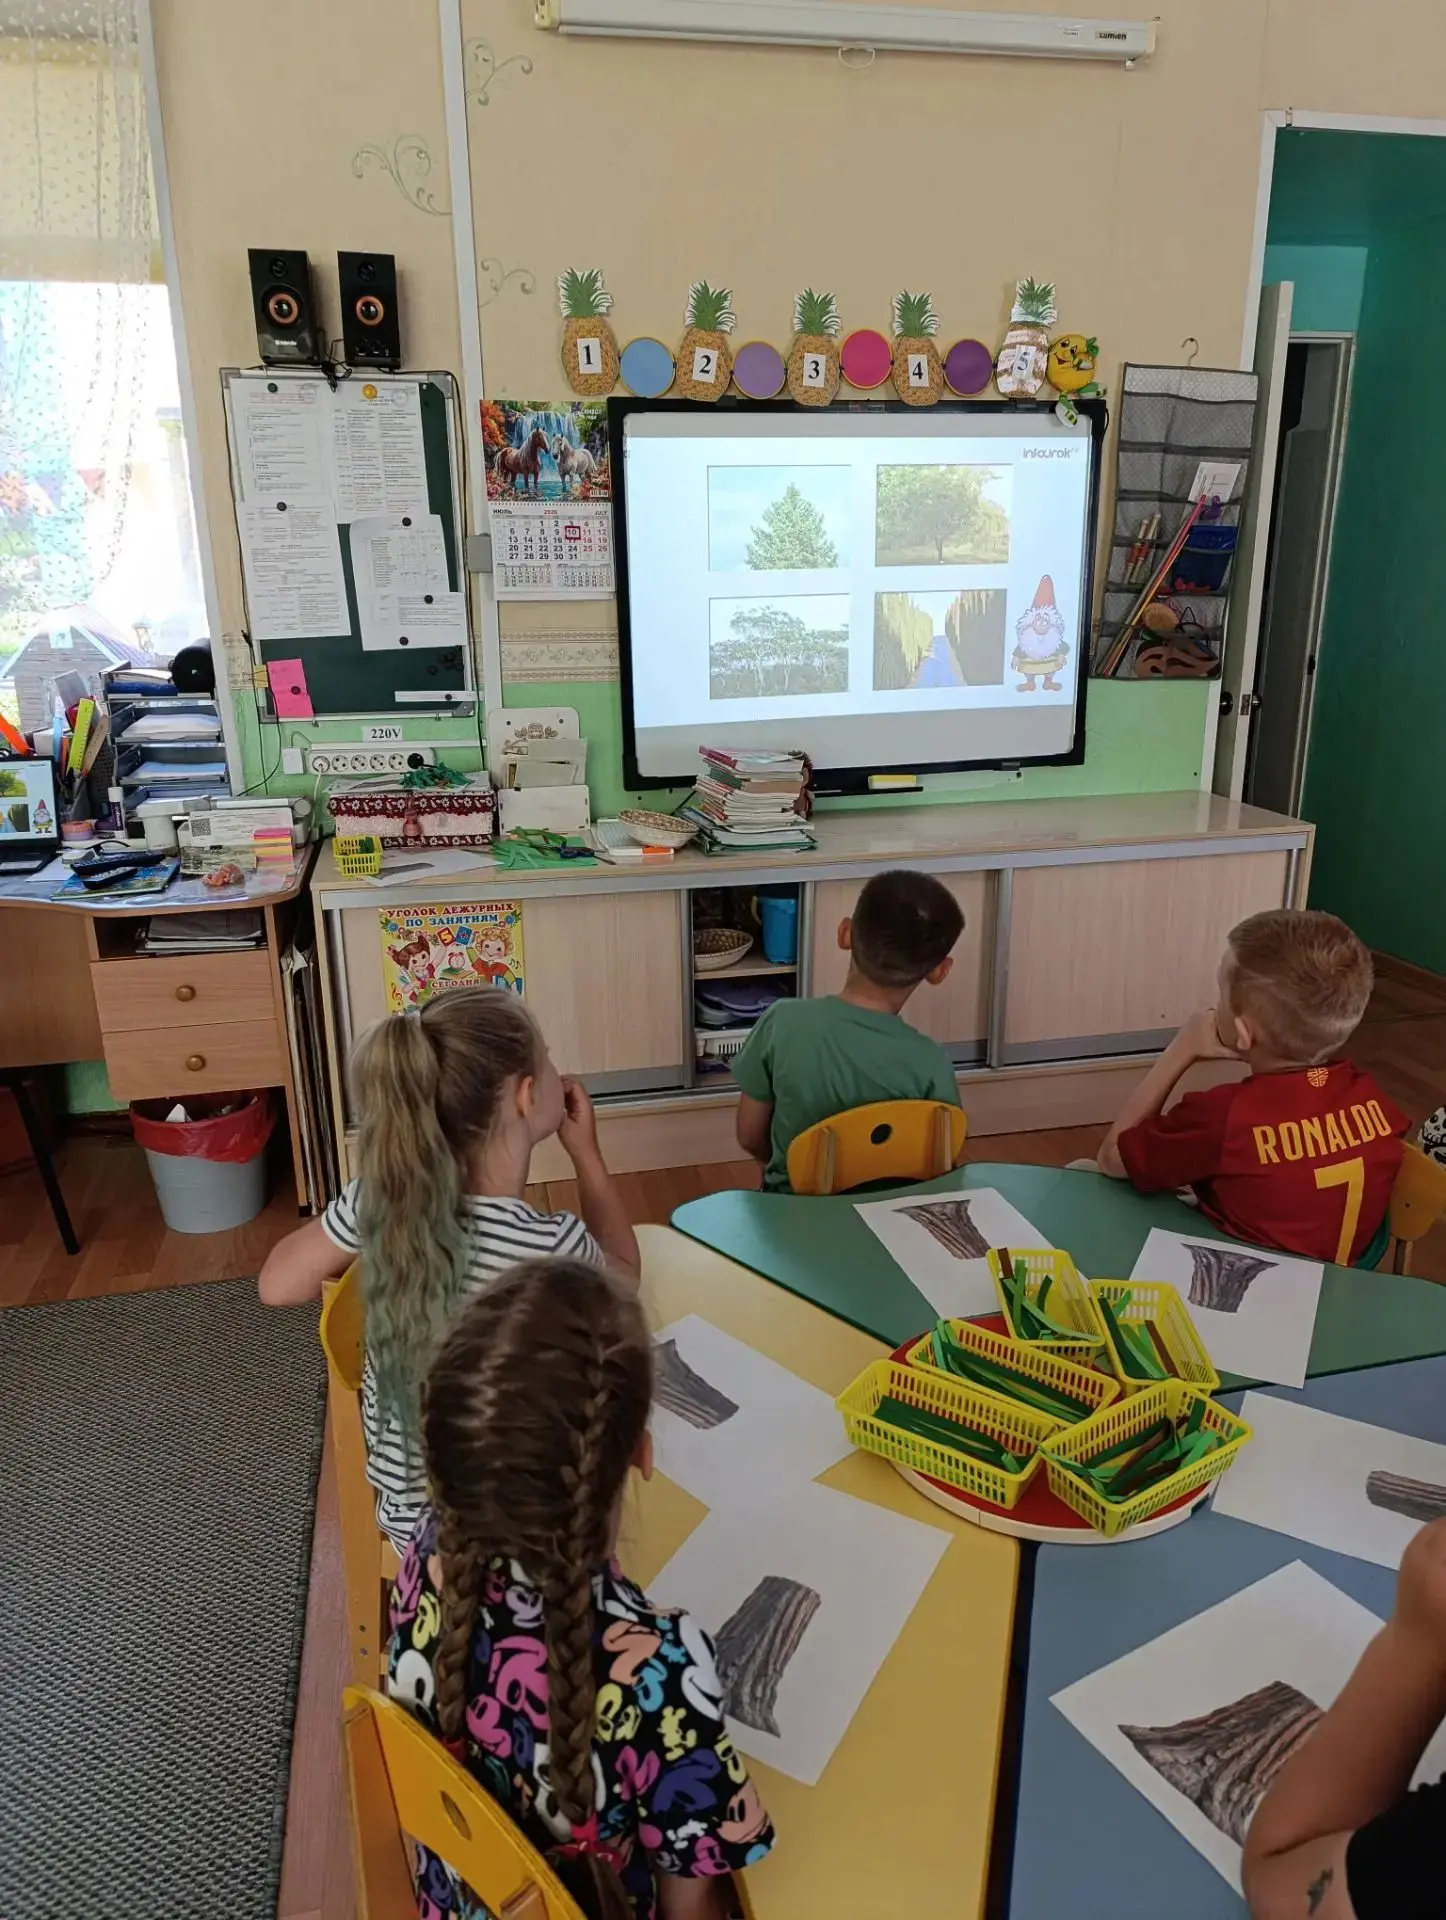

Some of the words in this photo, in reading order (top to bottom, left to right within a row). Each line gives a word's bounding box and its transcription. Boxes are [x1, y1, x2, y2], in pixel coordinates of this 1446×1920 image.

[583, 344, 593, 365] 1
[1017, 351, 1031, 371] 5
[699, 354, 712, 375] 2
[808, 360, 820, 380] 3
[912, 361, 924, 380] 4
[567, 528, 577, 536] 10
[371, 727, 401, 739] 220V
[386, 907, 437, 918] УГОЛОК
[442, 903, 514, 915] ДЕЖУРНЫХ
[405, 918, 424, 927] ПО
[431, 979, 480, 988] СЕГОДНЯ
[1252, 1099, 1392, 1165] RONALDO
[1314, 1156, 1365, 1267] 7
